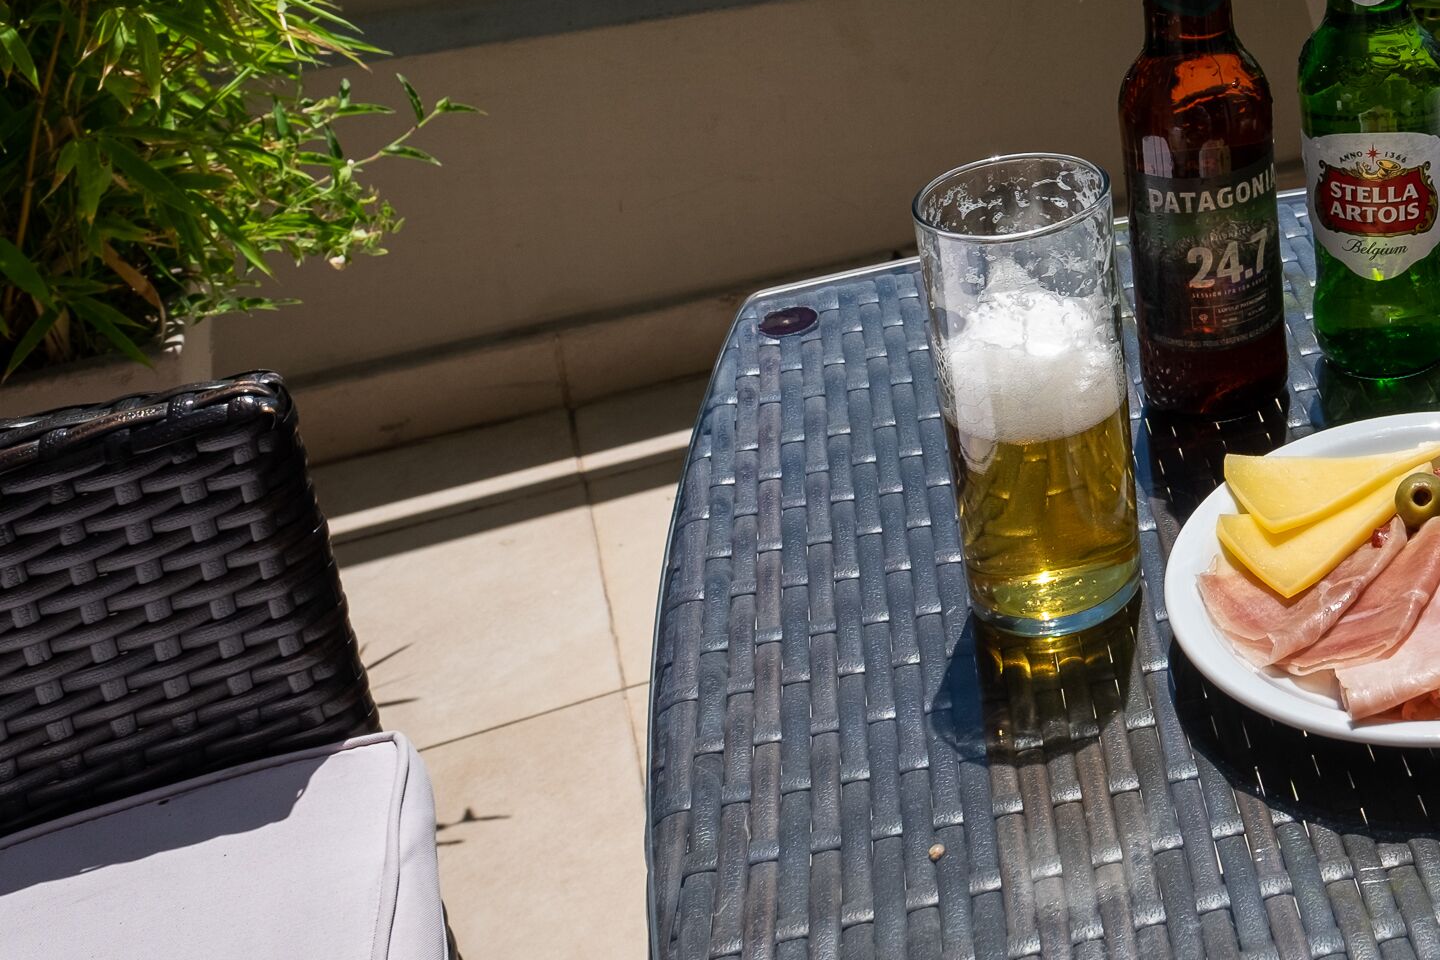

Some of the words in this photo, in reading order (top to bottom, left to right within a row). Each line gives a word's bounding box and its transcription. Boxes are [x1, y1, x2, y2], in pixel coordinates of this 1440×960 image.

[1339, 151, 1363, 163] ANNO
[1385, 151, 1408, 163] 1366
[1148, 162, 1276, 214] PATAGONIA
[1330, 181, 1419, 204] STELLA
[1330, 202, 1420, 224] ARTOIS
[1187, 227, 1268, 289] 24.7
[1342, 239, 1408, 261] Belgium
